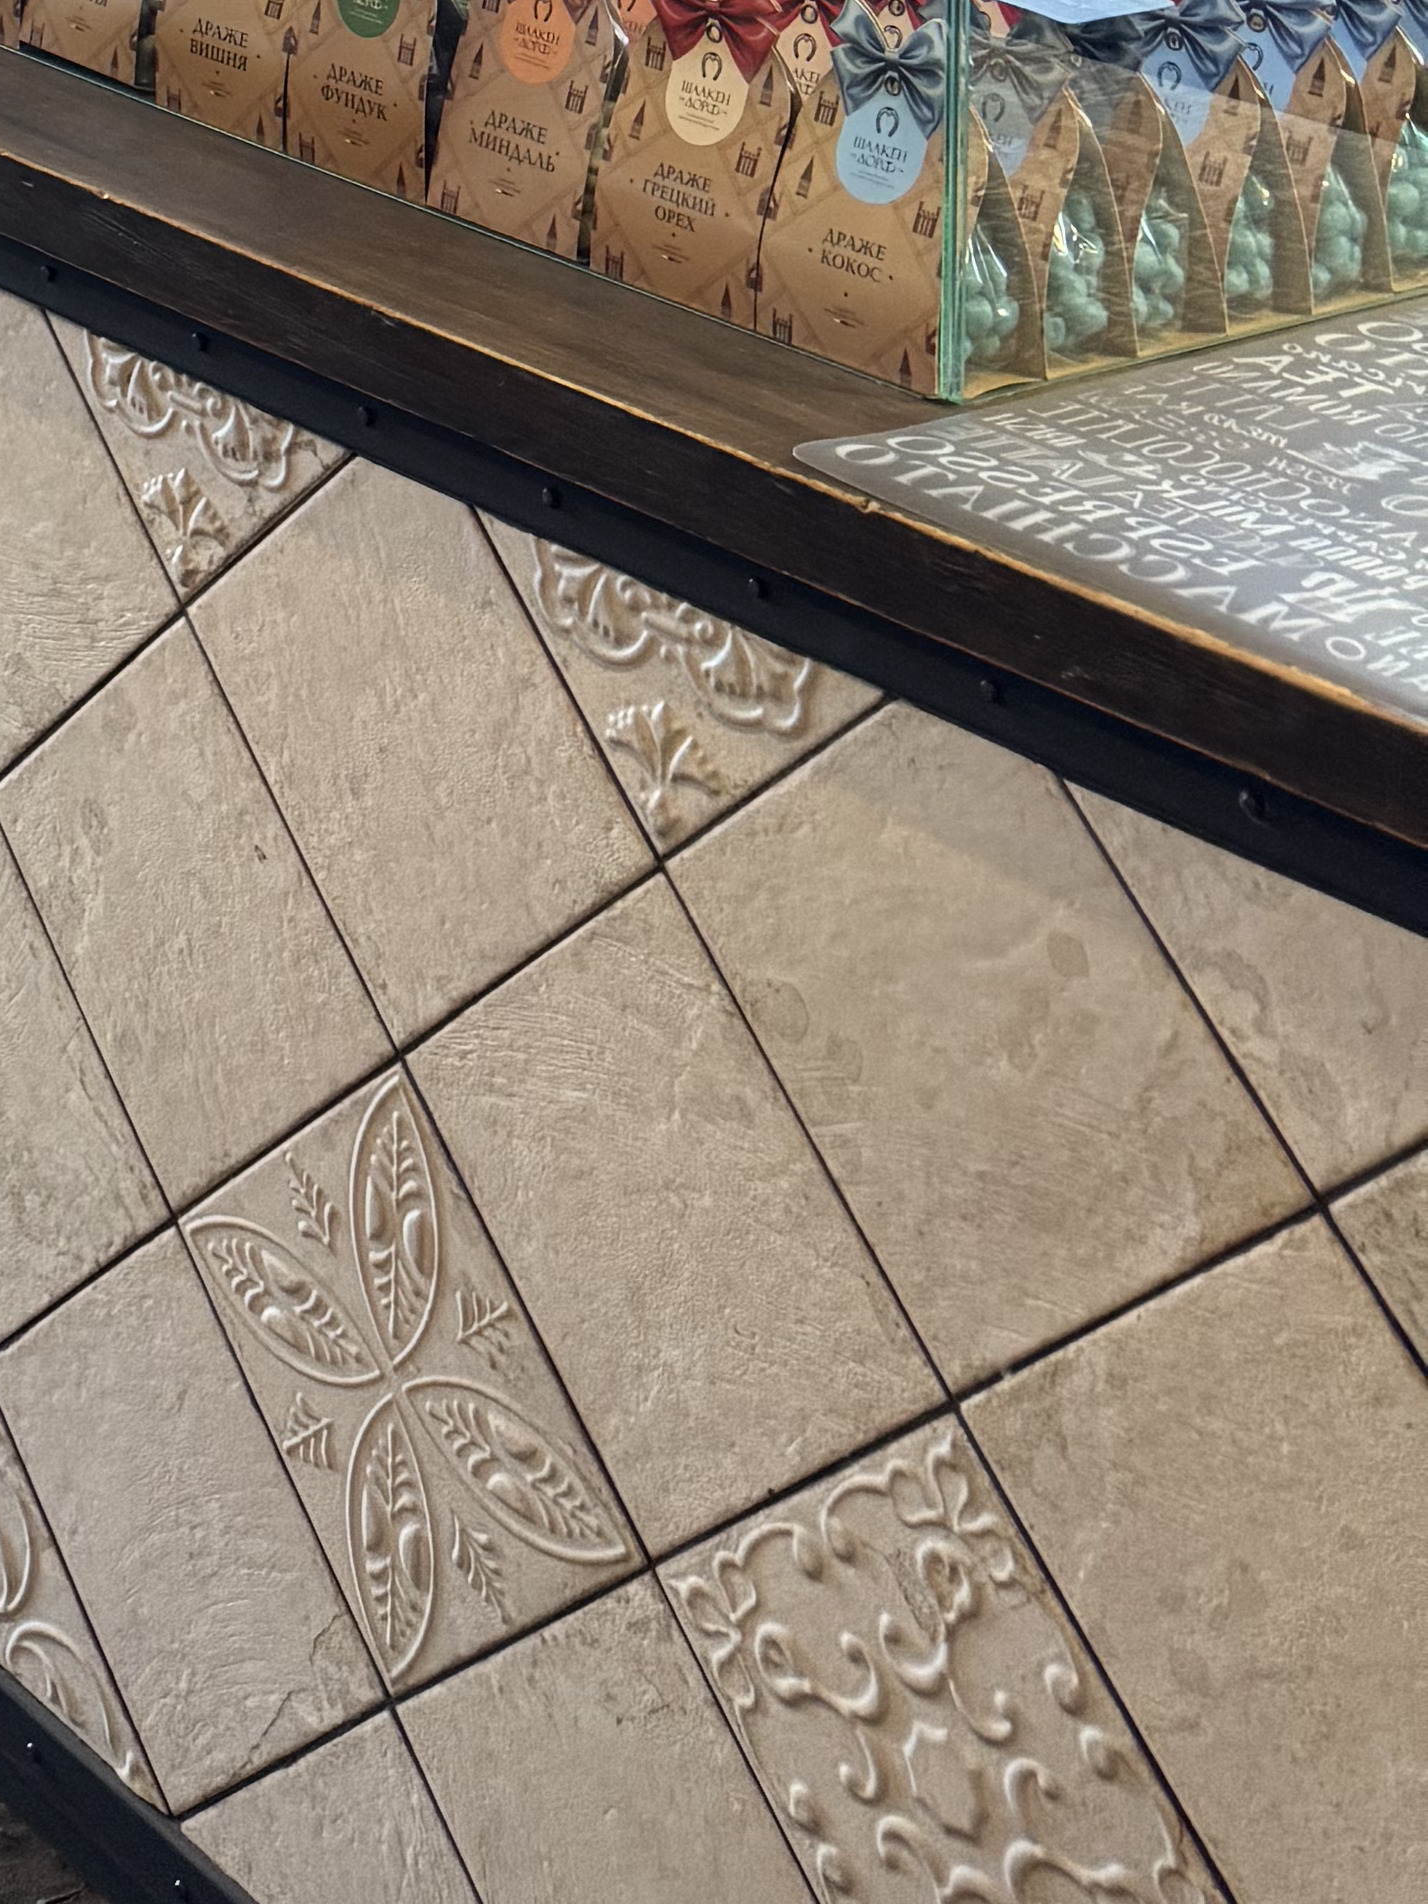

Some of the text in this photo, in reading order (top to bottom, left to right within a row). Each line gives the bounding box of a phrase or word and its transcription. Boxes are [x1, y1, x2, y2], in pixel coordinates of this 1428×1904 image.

[192, 18, 249, 49] ДРАЖЕ
[189, 38, 248, 72] ВИШНЯ
[326, 63, 385, 96] ДРАЖЕ
[321, 84, 388, 122] ФУНДУК
[484, 109, 548, 145] ДРАЖЕ
[469, 127, 556, 173] МИНДАЛЬ
[653, 162, 713, 193] ДРАЖЕ
[642, 179, 716, 216] ГРЕЦКИЙ
[654, 205, 695, 232] ОРЕХ
[822, 228, 887, 262] ДРАЖЕ
[820, 249, 884, 284] КОКОС
